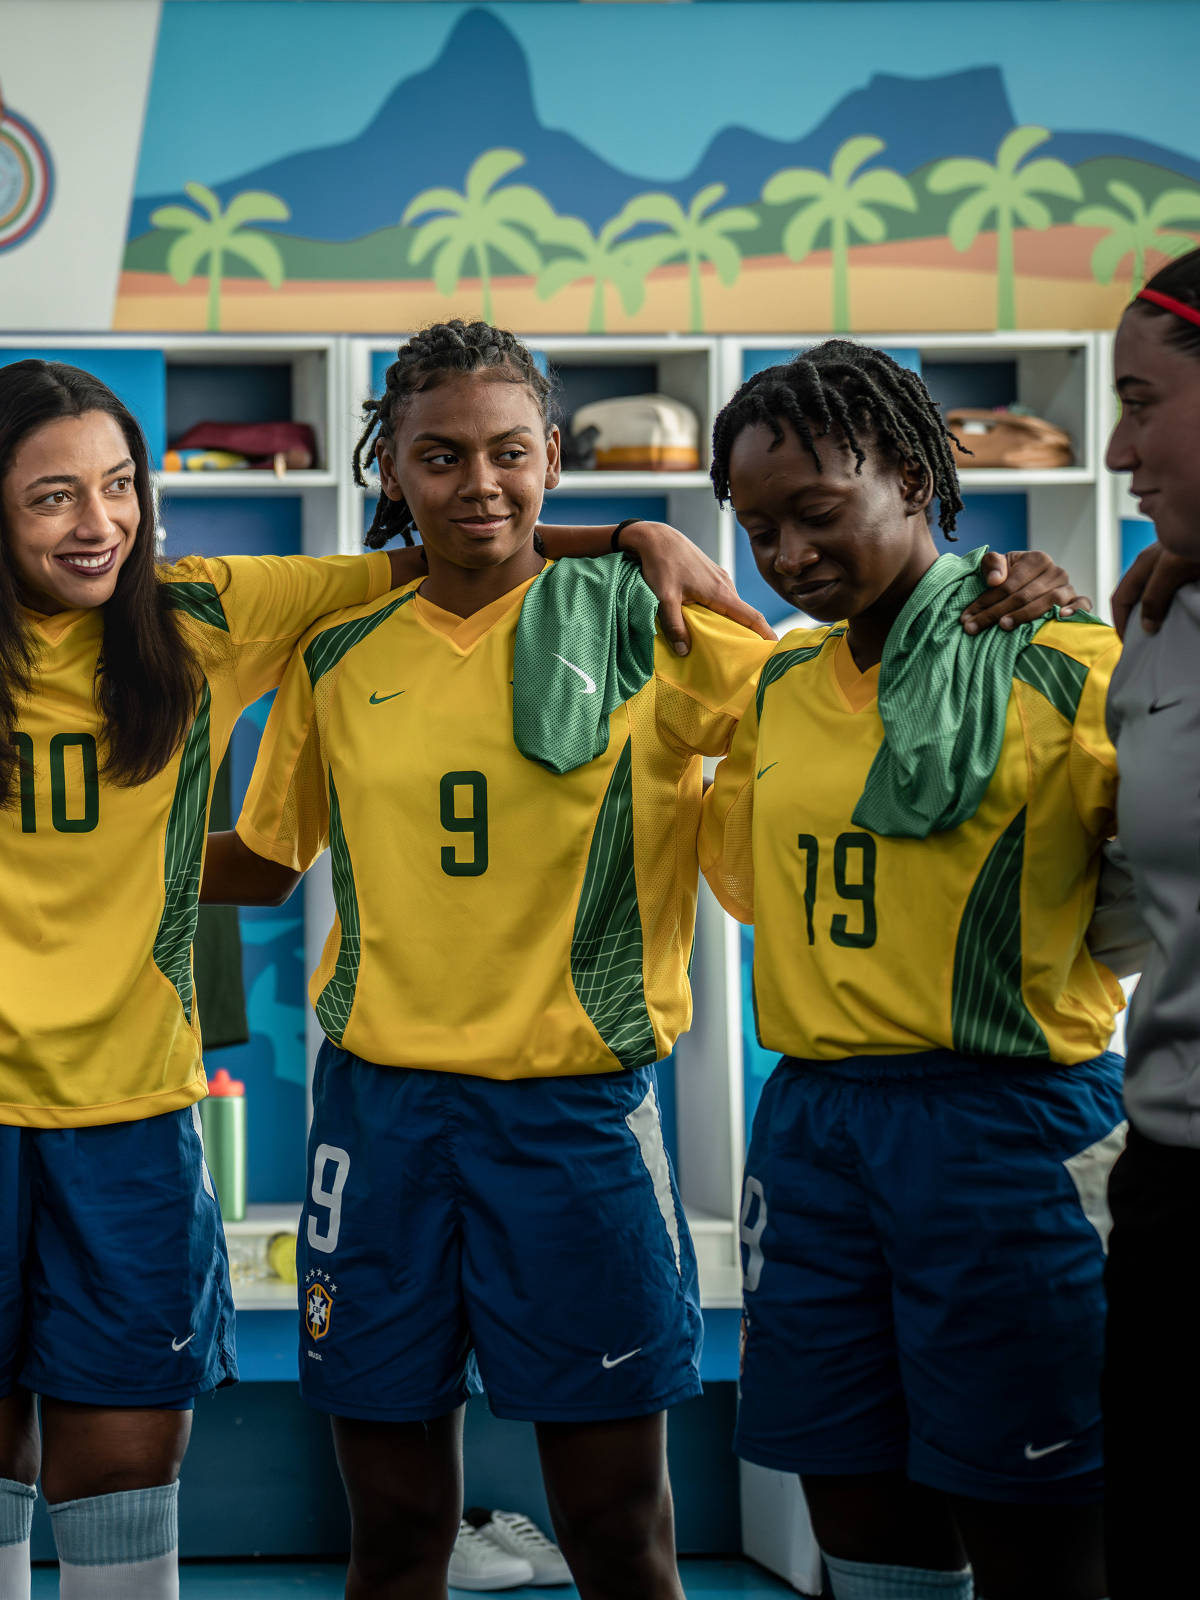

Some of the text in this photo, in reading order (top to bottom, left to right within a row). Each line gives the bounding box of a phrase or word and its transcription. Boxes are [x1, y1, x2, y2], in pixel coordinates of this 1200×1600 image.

[8, 732, 100, 834] 10
[440, 771, 488, 877] 9
[798, 832, 878, 949] 19
[307, 1144, 350, 1253] 9
